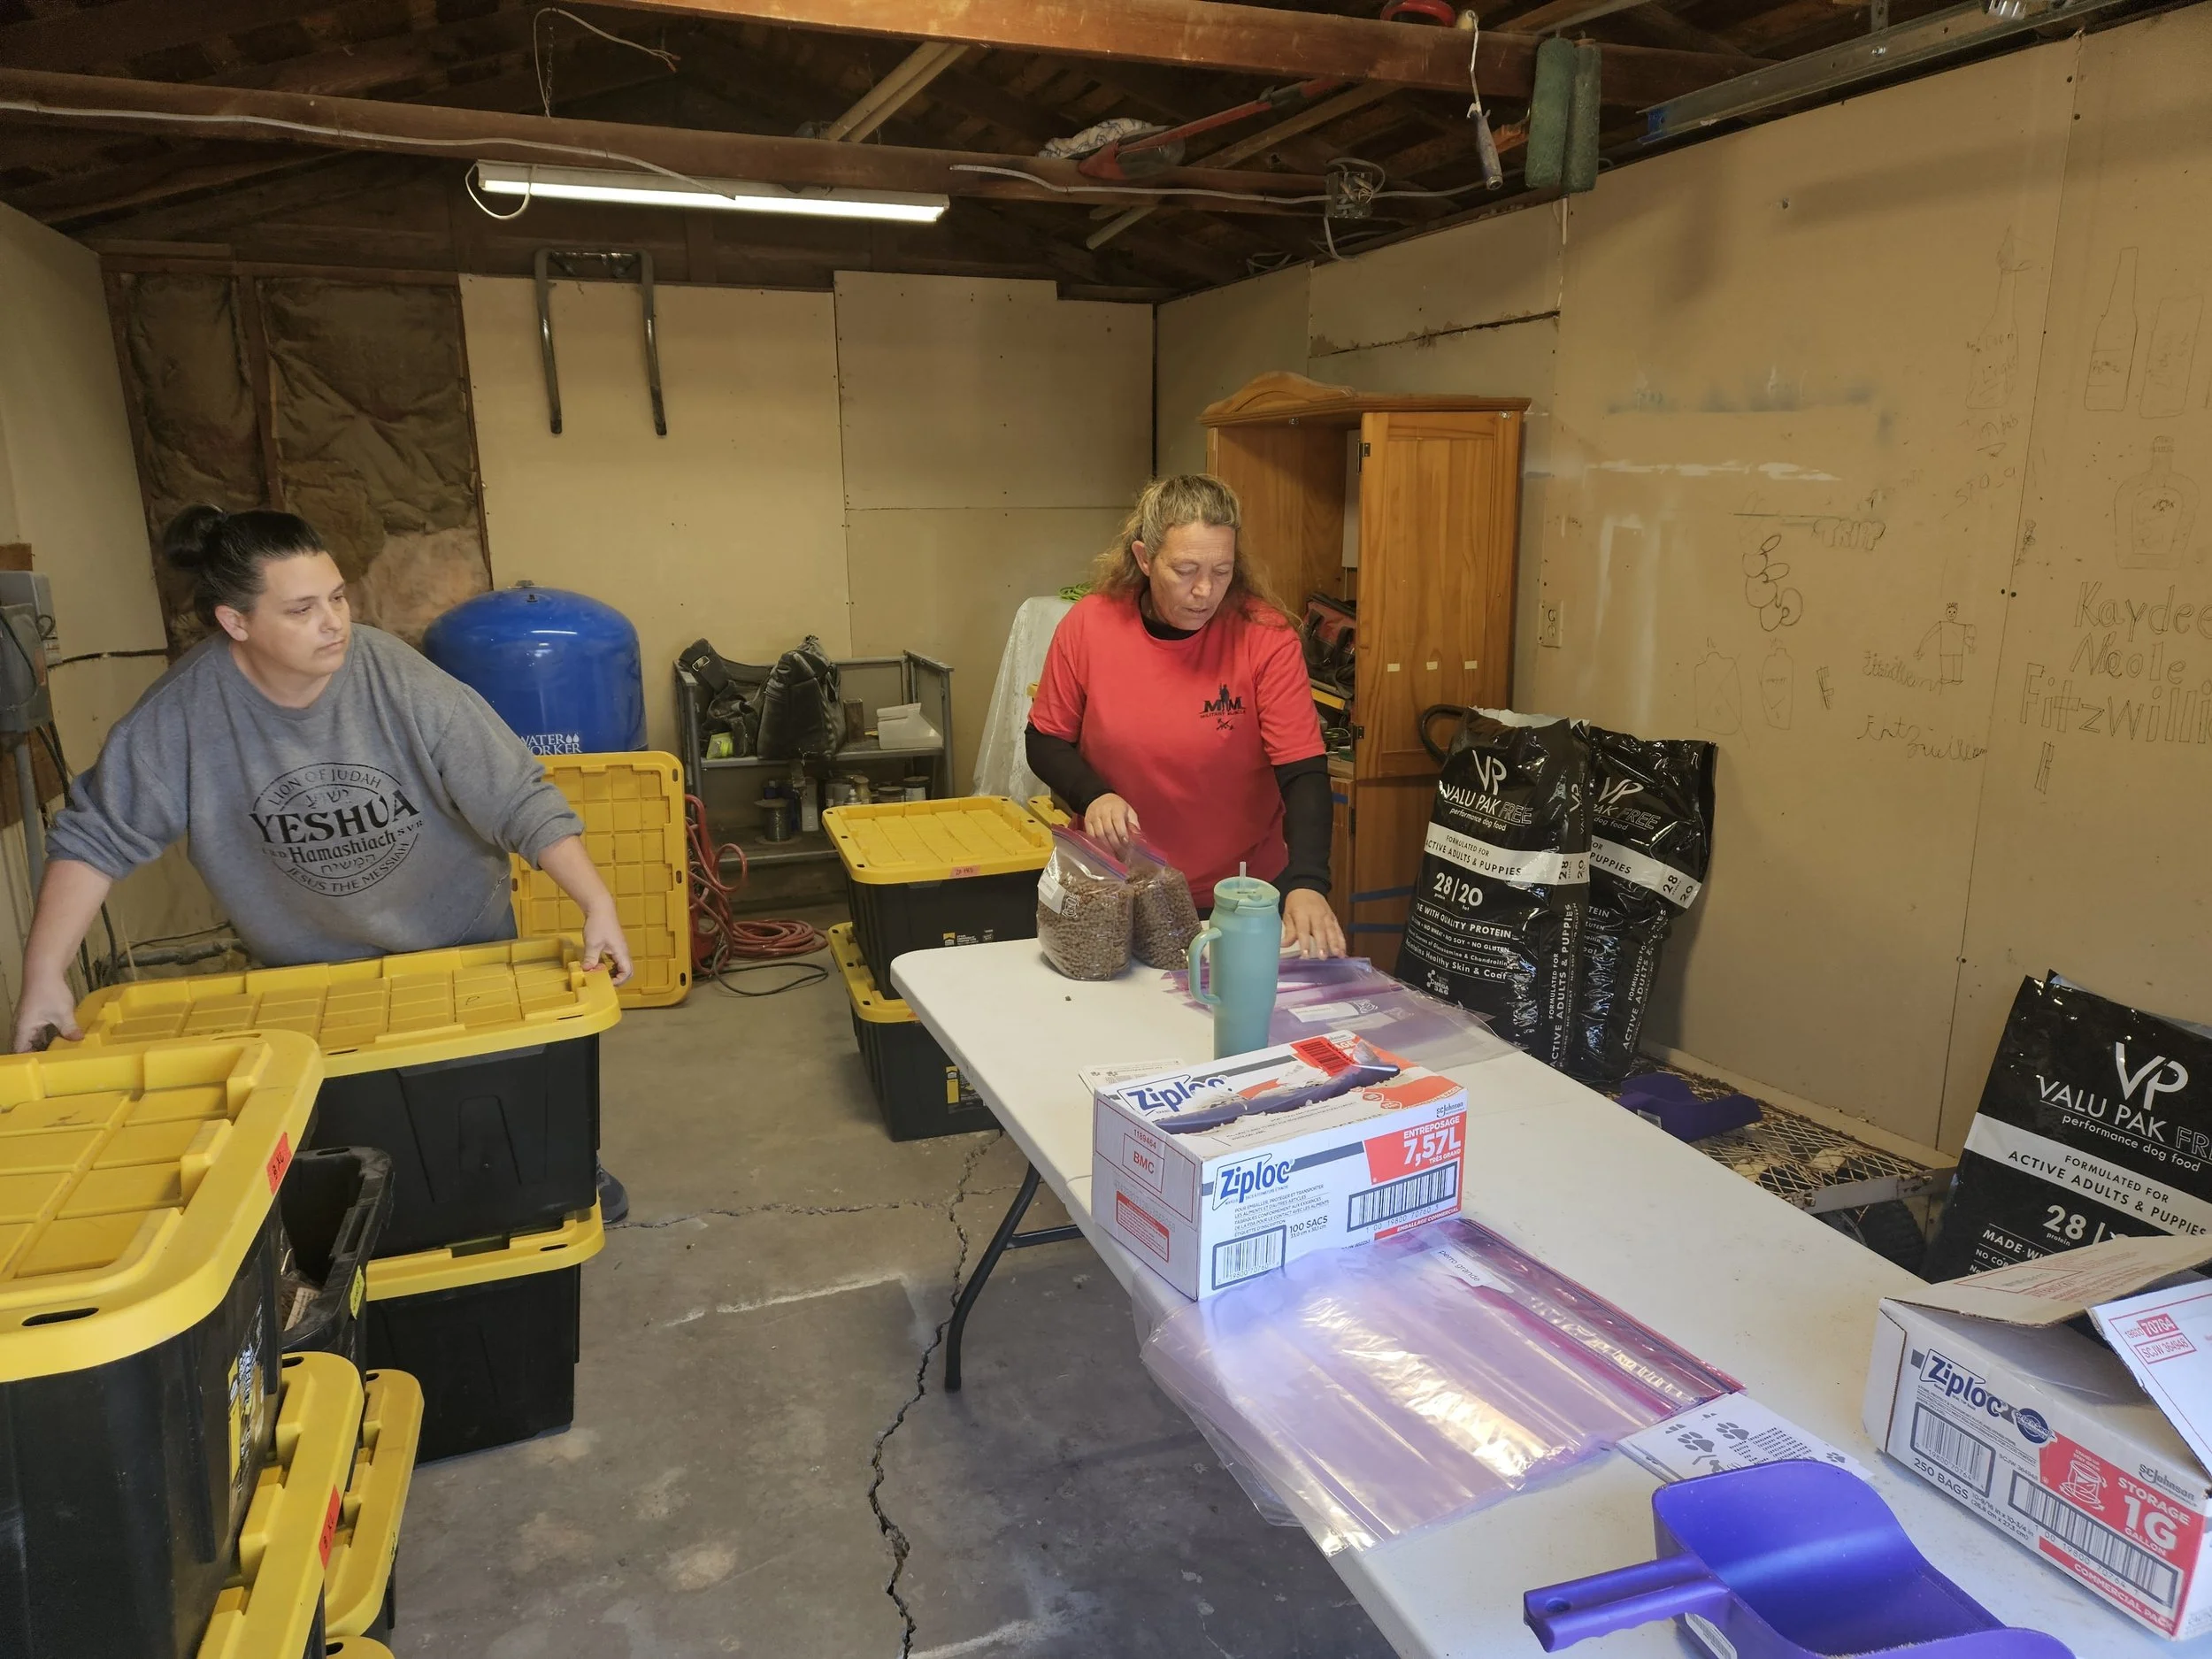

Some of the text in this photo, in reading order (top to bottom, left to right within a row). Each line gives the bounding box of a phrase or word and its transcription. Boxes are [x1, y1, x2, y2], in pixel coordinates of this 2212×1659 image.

[527, 742, 582, 756] ORKER
[268, 769, 382, 806] LION OF JUDAH
[1472, 749, 1507, 795] VP
[249, 789, 420, 844] YESHUA
[1445, 783, 1533, 825] VALU PAK FREE
[1448, 807, 1507, 832] performance dog food
[1617, 807, 1662, 830] FREE
[1594, 817, 1628, 831] dog food
[288, 829, 397, 864] Hamashiach
[1425, 839, 1448, 854] ACTIVE
[1448, 848, 1471, 864] ADULTS
[1479, 861, 1522, 876] PUPPIES
[1446, 834, 1490, 856] FORMULATED FOR
[1592, 841, 1602, 850] OR
[287, 841, 411, 893] JESUS THE MESSIAH
[1589, 852, 1632, 874] PUPPIES
[1433, 872, 1484, 907] 28 20
[1424, 905, 1512, 939] WITH QUALITY PROTEIN
[1586, 921, 1605, 931] LUTEN
[1588, 906, 1610, 918] TEIN
[1425, 949, 1449, 969] Healthy
[1452, 960, 1471, 974] Skin
[1432, 941, 1463, 957] Glucosamine
[1471, 954, 1507, 966] Chondroitin
[1453, 936, 1465, 945] SOY
[1471, 941, 1482, 949] NO
[1484, 943, 1510, 953] GLUTEN
[1548, 970, 1559, 1019] FORMULATED
[1549, 1025, 1563, 1068] ACTIVE
[1556, 972, 1567, 1019] ADULTS
[1562, 903, 1573, 953] PUPPIES
[1627, 956, 1643, 1002] FORMULATED
[1623, 959, 1648, 1050] ACTIVE ADULTS
[2115, 1041, 2189, 1110] VP
[1403, 1115, 1460, 1140] ENTREPOSAGE
[2038, 1076, 2212, 1161] VALU PAK FR
[1403, 1126, 1462, 1166] 7,57L
[1443, 1148, 1462, 1160] GRAND
[2062, 1114, 2201, 1172] performance dog food
[1133, 1151, 1155, 1174] BMC
[2064, 1154, 2170, 1203] FORMULATED FOR
[1220, 1161, 1290, 1203] Ziploc
[2008, 1149, 2067, 1180] ACTIVE
[2070, 1173, 2129, 1206] ADULTS
[2134, 1200, 2145, 1213] &
[1289, 1215, 1328, 1234] 100 SACS
[1387, 1215, 1408, 1226] 19800
[1396, 1207, 1459, 1233] EMBALLAGE COMMERCIAL
[2042, 1204, 2087, 1240] 28
[1982, 1229, 2021, 1254] MADE
[2047, 1231, 2071, 1247] protein
[1439, 1250, 1479, 1281] perro grande
[1975, 1248, 2009, 1266] NO COR
[2141, 1317, 2176, 1336] 70764
[2141, 1345, 2165, 1358] SCJW
[1928, 1356, 2002, 1417] Ziploc
[1914, 1457, 1970, 1500] 250 BAGS
[1927, 1448, 1973, 1480] 19800 70764
[2117, 1476, 2191, 1526] STORAGE
[2124, 1495, 2177, 1551] 1G
[2045, 1532, 2056, 1543] 00
[2062, 1543, 2091, 1566] 19800
[2124, 1527, 2167, 1556] GALLON
[2074, 1563, 2141, 1612] COMMERCIAL
[2143, 1609, 2174, 1632] PACK
